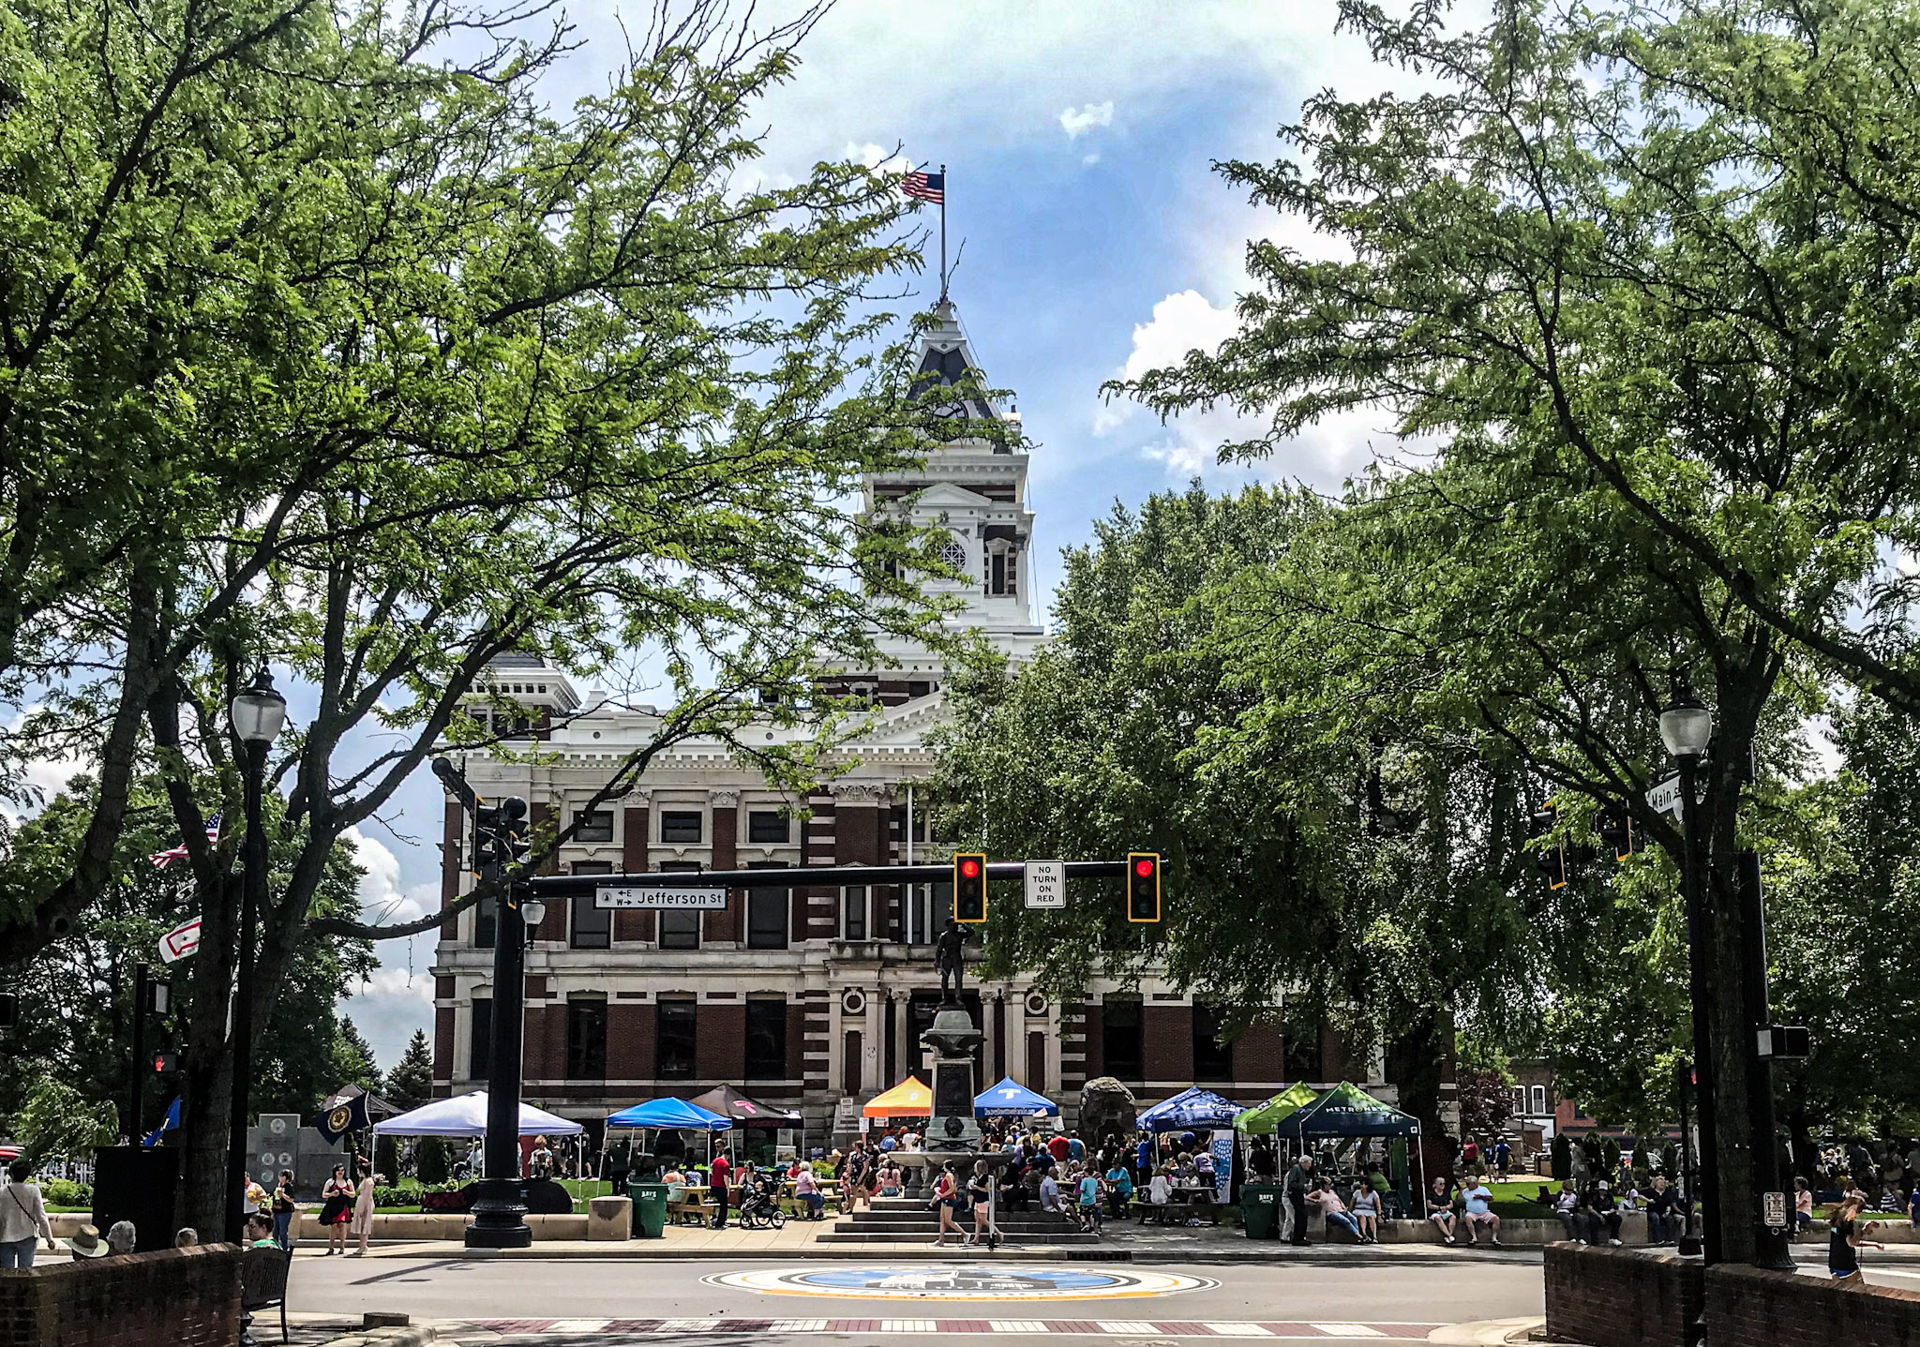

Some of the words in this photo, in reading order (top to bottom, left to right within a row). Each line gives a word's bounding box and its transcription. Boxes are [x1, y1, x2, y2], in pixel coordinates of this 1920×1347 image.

[1651, 789, 1672, 808] Main
[637, 891, 706, 905] Jefferson
[709, 893, 722, 903] St
